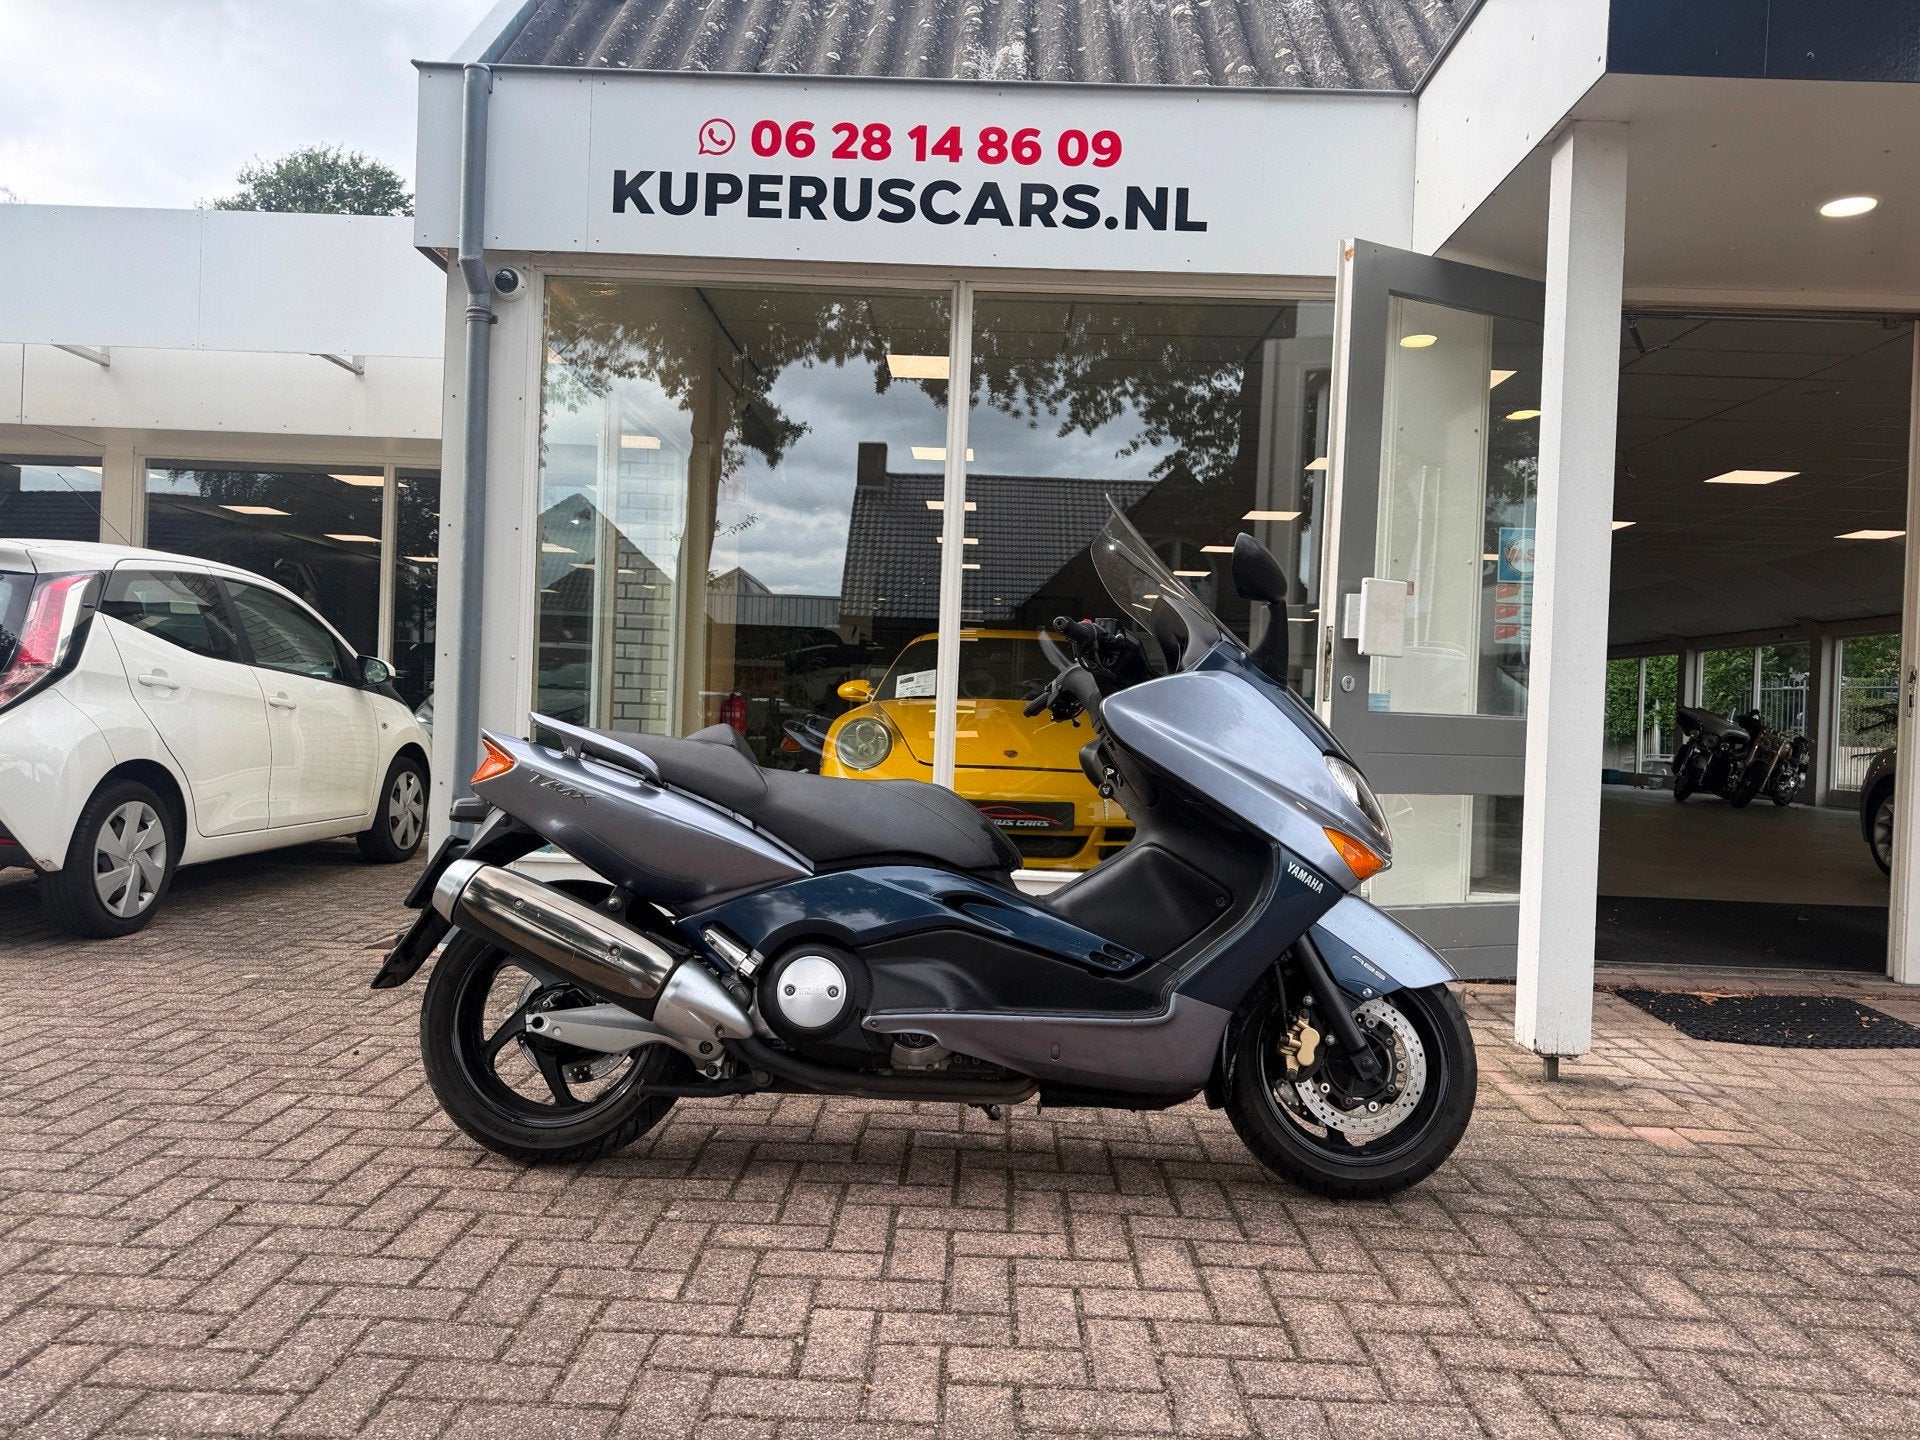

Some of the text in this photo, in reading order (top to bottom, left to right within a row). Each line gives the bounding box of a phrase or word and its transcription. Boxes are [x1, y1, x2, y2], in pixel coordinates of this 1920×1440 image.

[750, 119, 1123, 169] 06 28 14 86 09
[612, 169, 1208, 232] KUPERUSCARS.NL
[1285, 861, 1324, 894] YAMAHA
[1351, 954, 1387, 981] ABS
